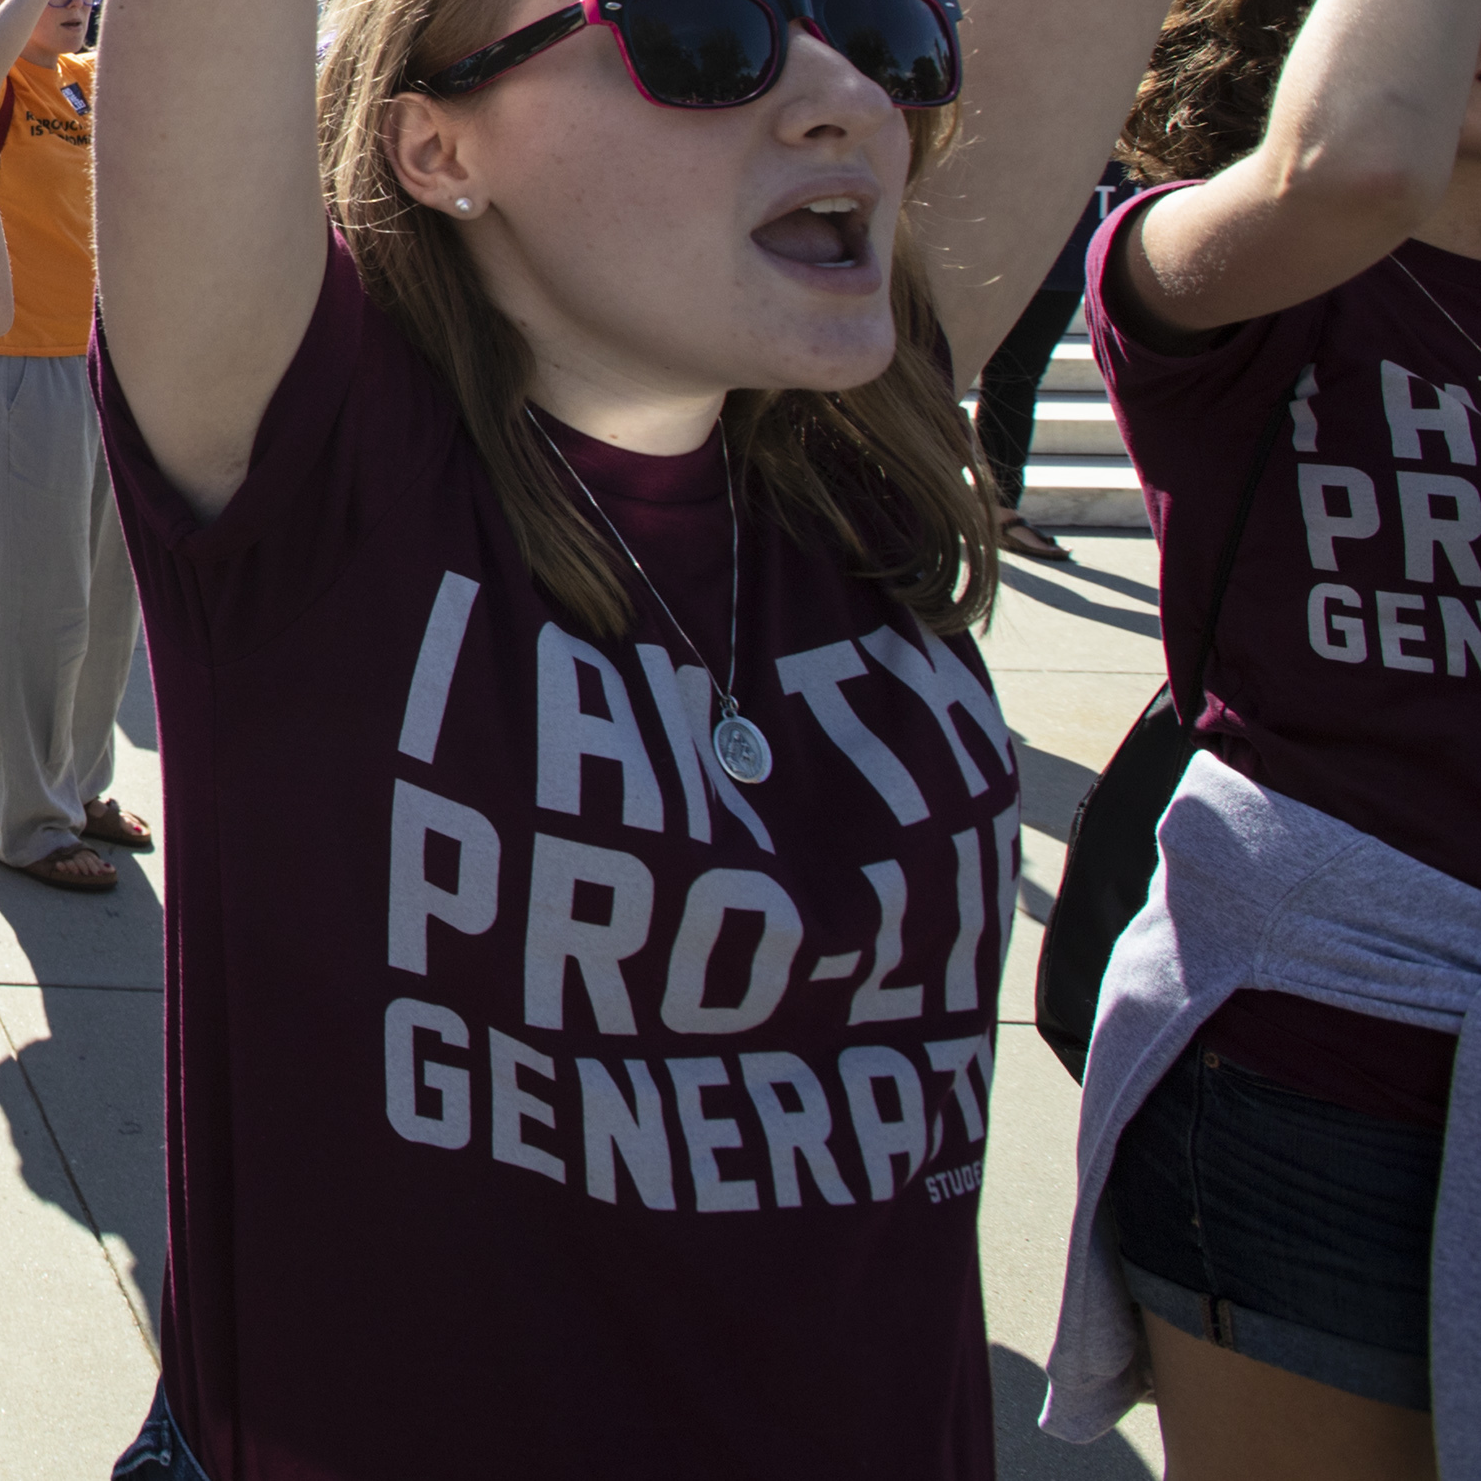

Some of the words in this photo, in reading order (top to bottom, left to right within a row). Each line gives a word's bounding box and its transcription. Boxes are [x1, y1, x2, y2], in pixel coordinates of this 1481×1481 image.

[30, 124, 44, 136] IS
[398, 569, 481, 765] I
[383, 996, 993, 1213] GENERAT
